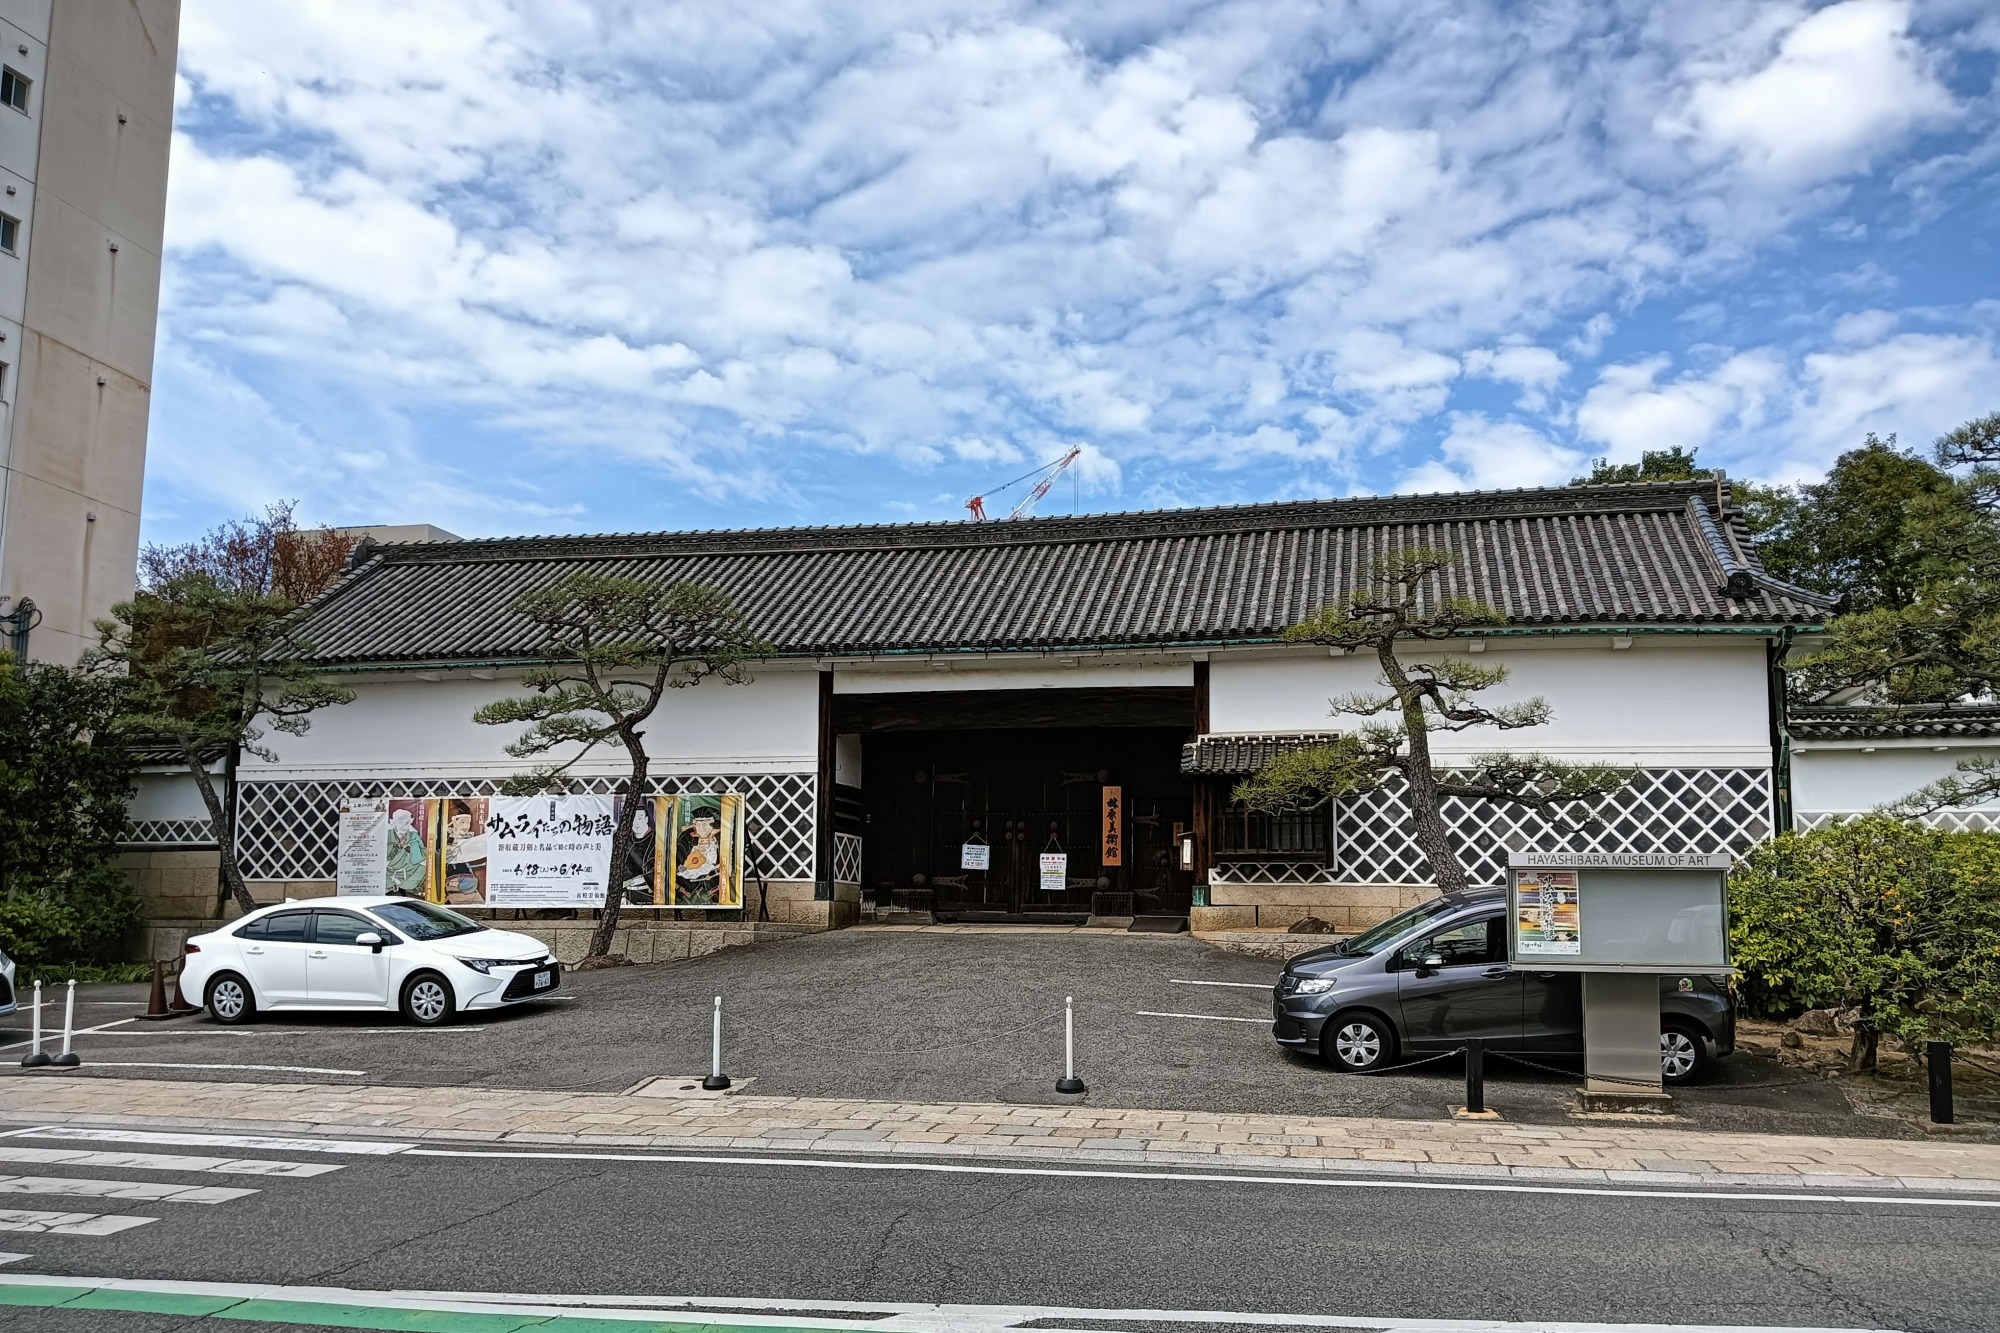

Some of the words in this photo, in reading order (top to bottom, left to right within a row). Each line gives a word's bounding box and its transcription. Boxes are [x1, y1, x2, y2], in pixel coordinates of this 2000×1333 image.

[486, 813, 615, 839] サムライたちの物語
[1105, 797, 1119, 858] 林原美術館
[1527, 855, 1609, 866] HAYASHIBARA
[1611, 855, 1665, 866] MUSEUM
[1668, 855, 1684, 866] OF
[1687, 855, 1711, 866] ART
